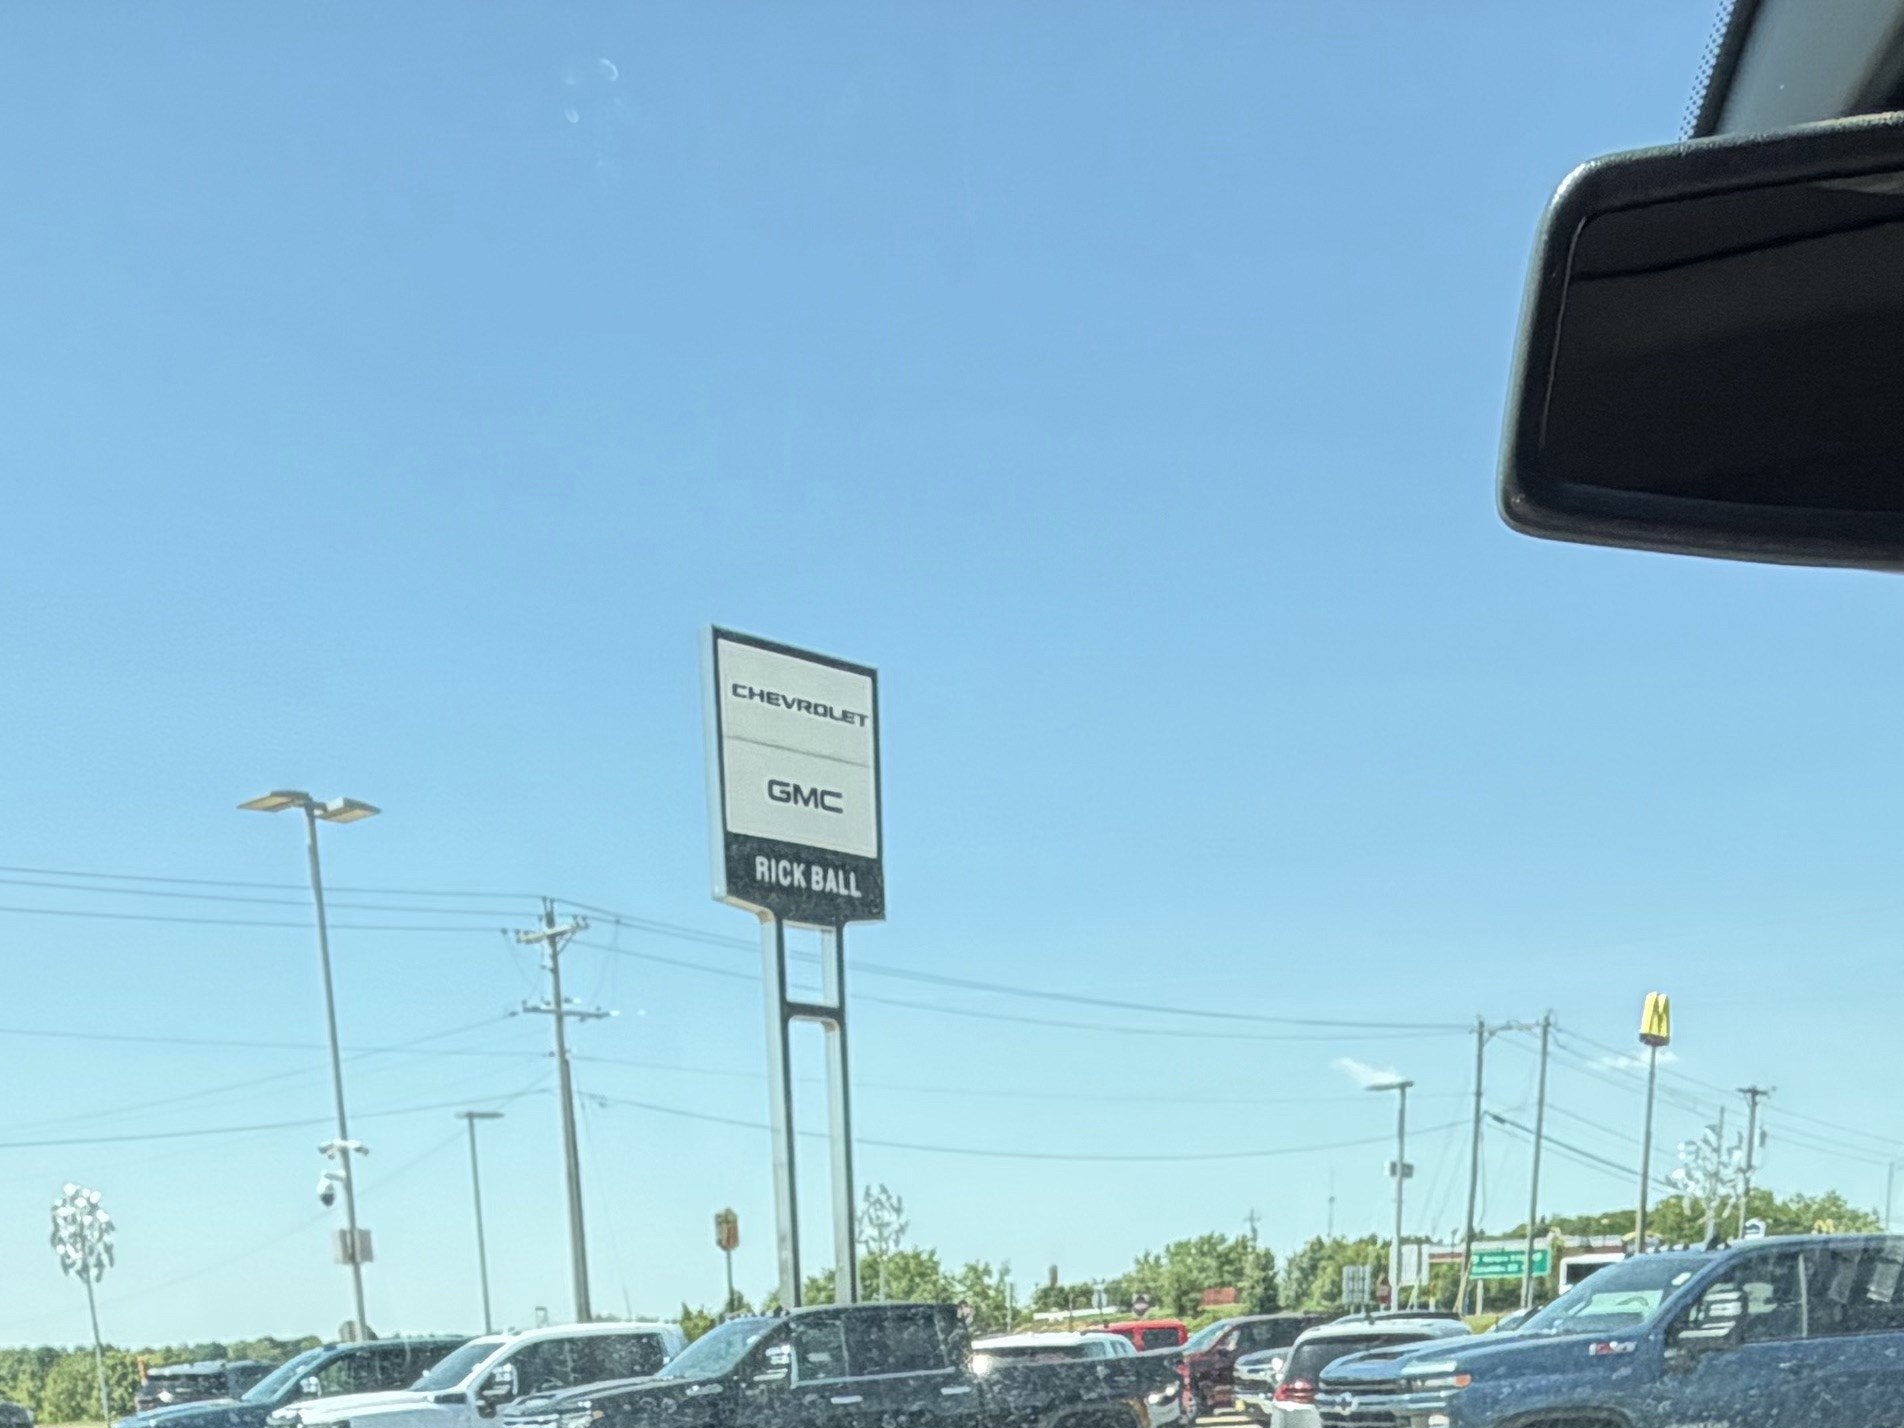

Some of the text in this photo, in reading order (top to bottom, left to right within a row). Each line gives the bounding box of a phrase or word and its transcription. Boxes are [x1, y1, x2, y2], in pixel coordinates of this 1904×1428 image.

[731, 682, 869, 728] CHEVROLET
[767, 778, 844, 814] GMC
[754, 855, 862, 898] RICK BALL
